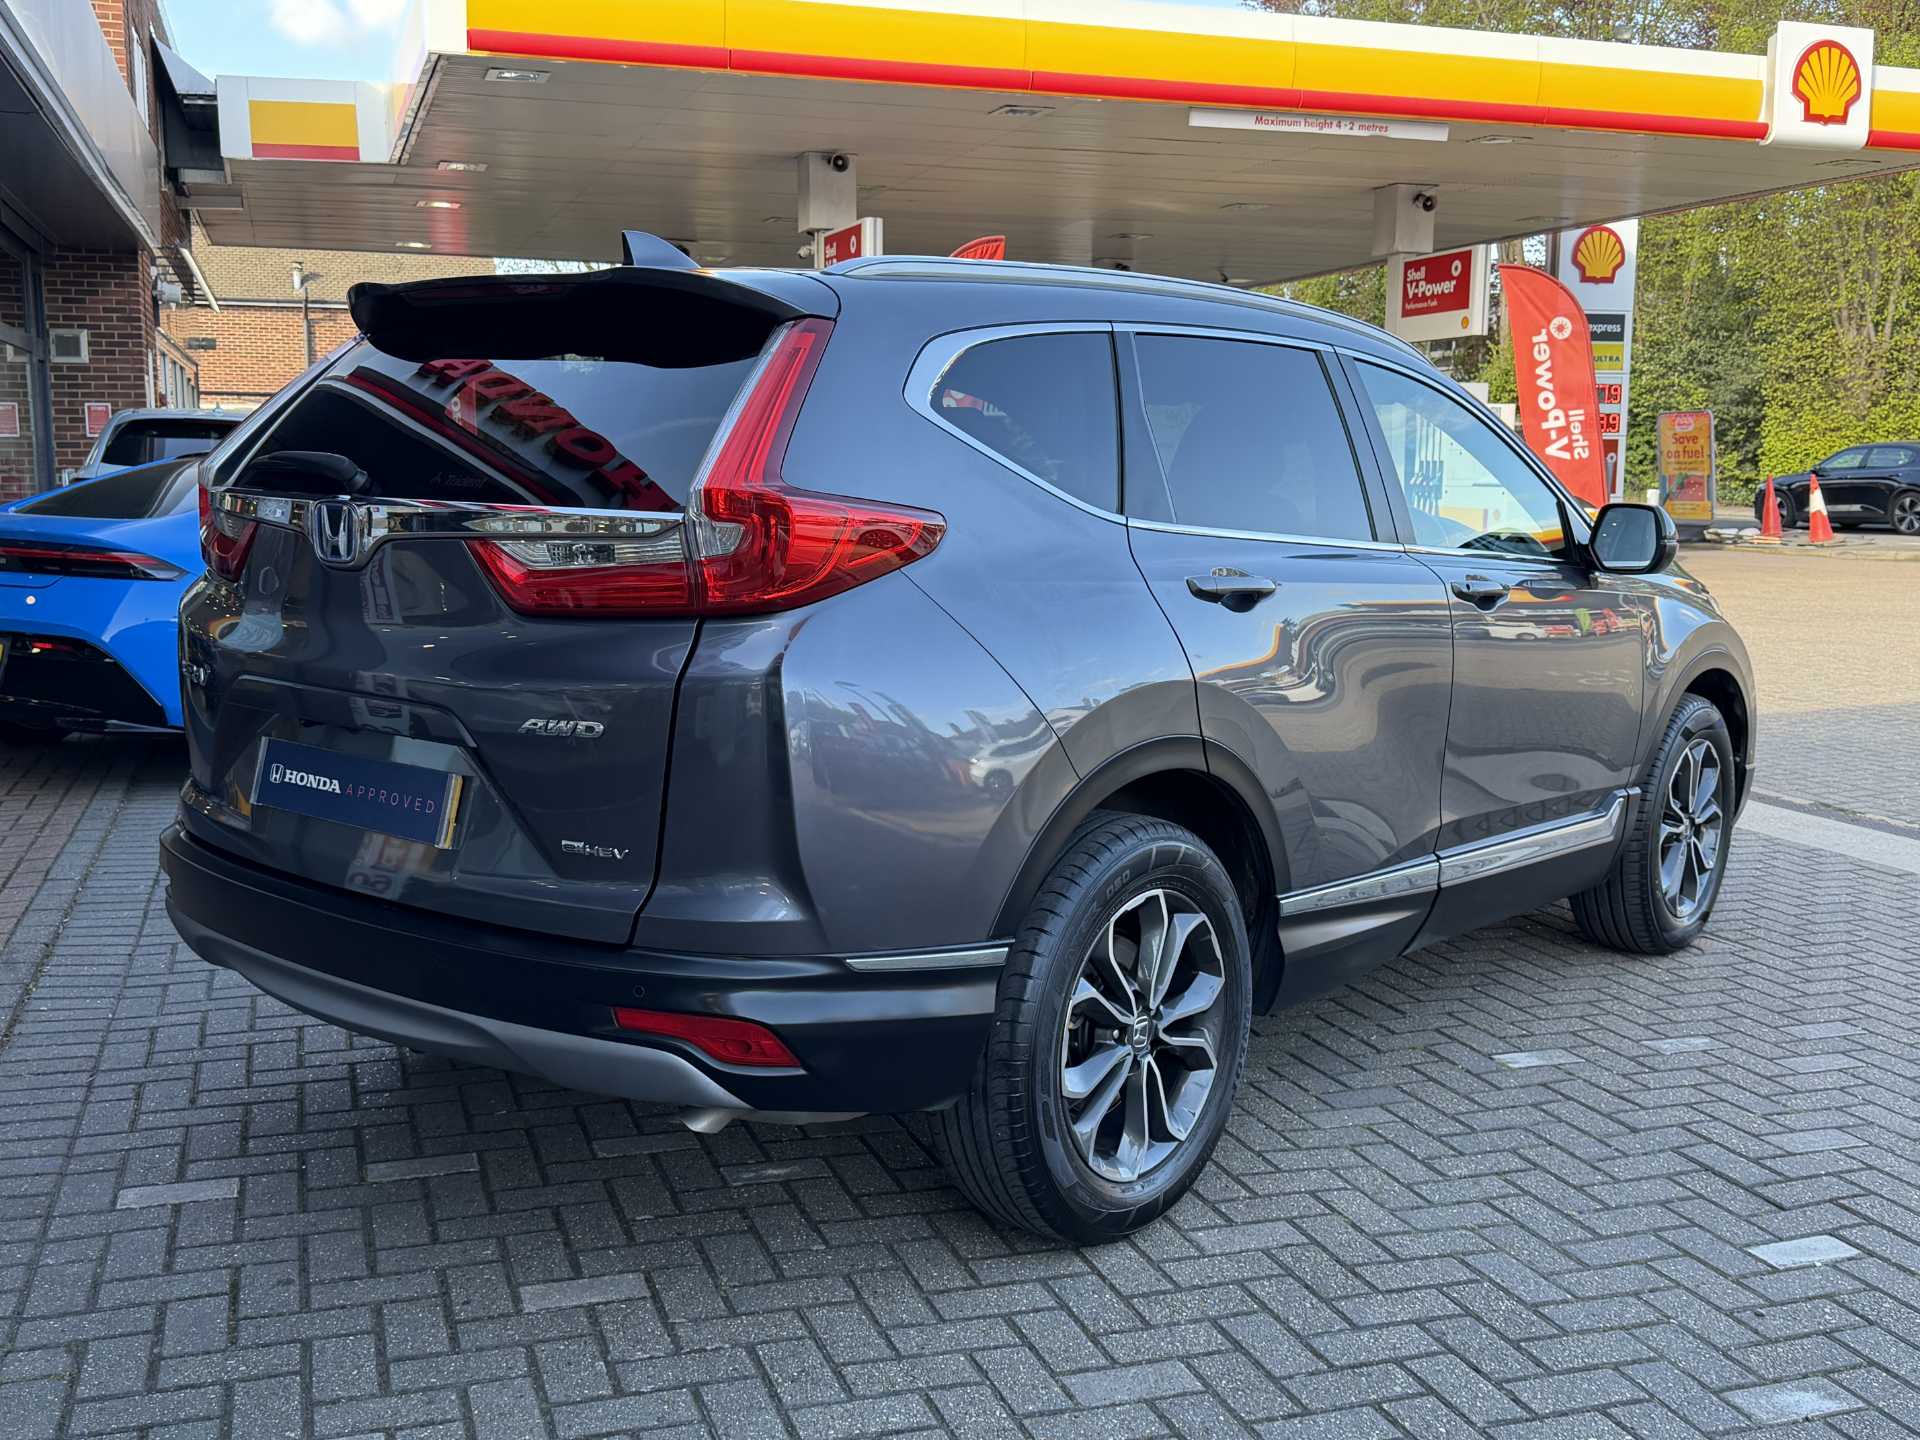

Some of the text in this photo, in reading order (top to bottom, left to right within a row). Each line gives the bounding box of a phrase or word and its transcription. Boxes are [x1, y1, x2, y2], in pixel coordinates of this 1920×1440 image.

[1254, 115, 1302, 127] Maximum
[1303, 118, 1334, 131] height
[1357, 122, 1389, 133] metres
[1407, 266, 1426, 281] Shell
[1407, 279, 1457, 299] V-Power
[1672, 432, 1698, 445] Save
[1682, 446, 1705, 460] fuel
[517, 718, 605, 738] AWD
[283, 769, 435, 814] HONDA APPROVED
